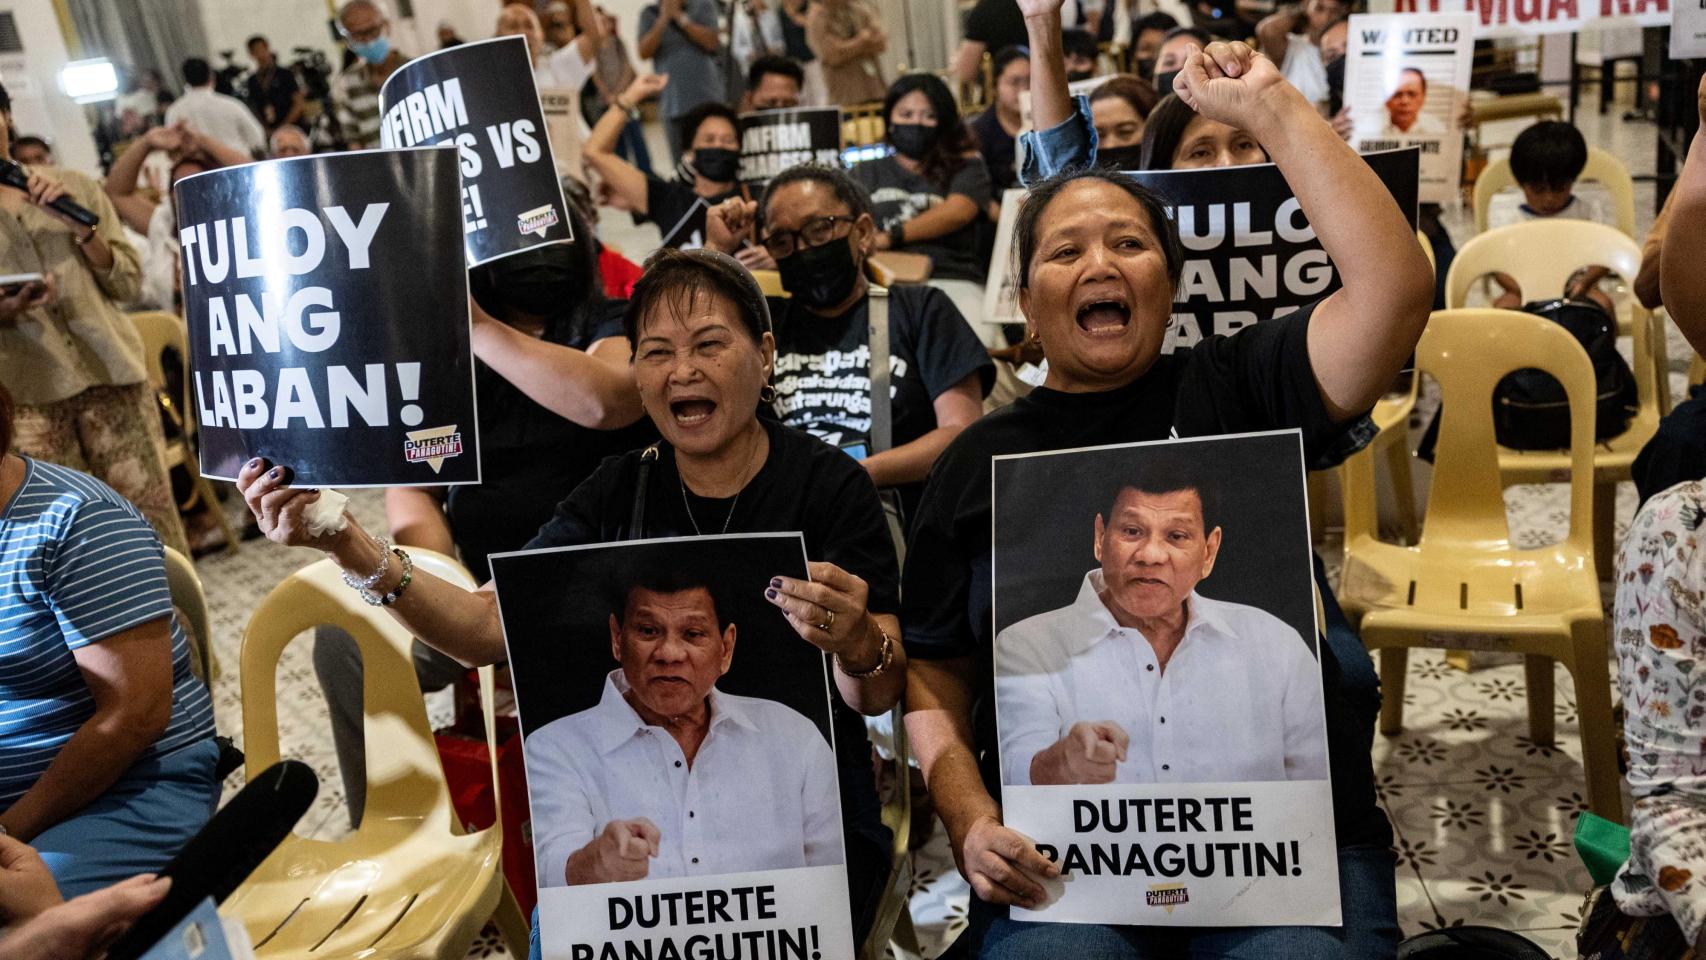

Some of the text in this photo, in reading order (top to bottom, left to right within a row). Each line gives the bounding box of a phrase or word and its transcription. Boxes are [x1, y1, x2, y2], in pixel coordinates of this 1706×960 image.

[1361, 28, 1458, 45] WTED
[381, 77, 469, 149] NFIRM
[486, 118, 541, 168] VS
[180, 202, 390, 286] TULOY
[1163, 196, 1318, 251] ULO
[1173, 249, 1333, 303] ANG
[208, 286, 341, 357] ANG
[773, 344, 908, 378] arapatn
[194, 362, 424, 430] LABAN!
[406, 434, 460, 450] DUTERTE
[1073, 797, 1254, 833] DUTERTE
[608, 885, 777, 930] DUTERTE
[1146, 887, 1188, 898] DUTERTE
